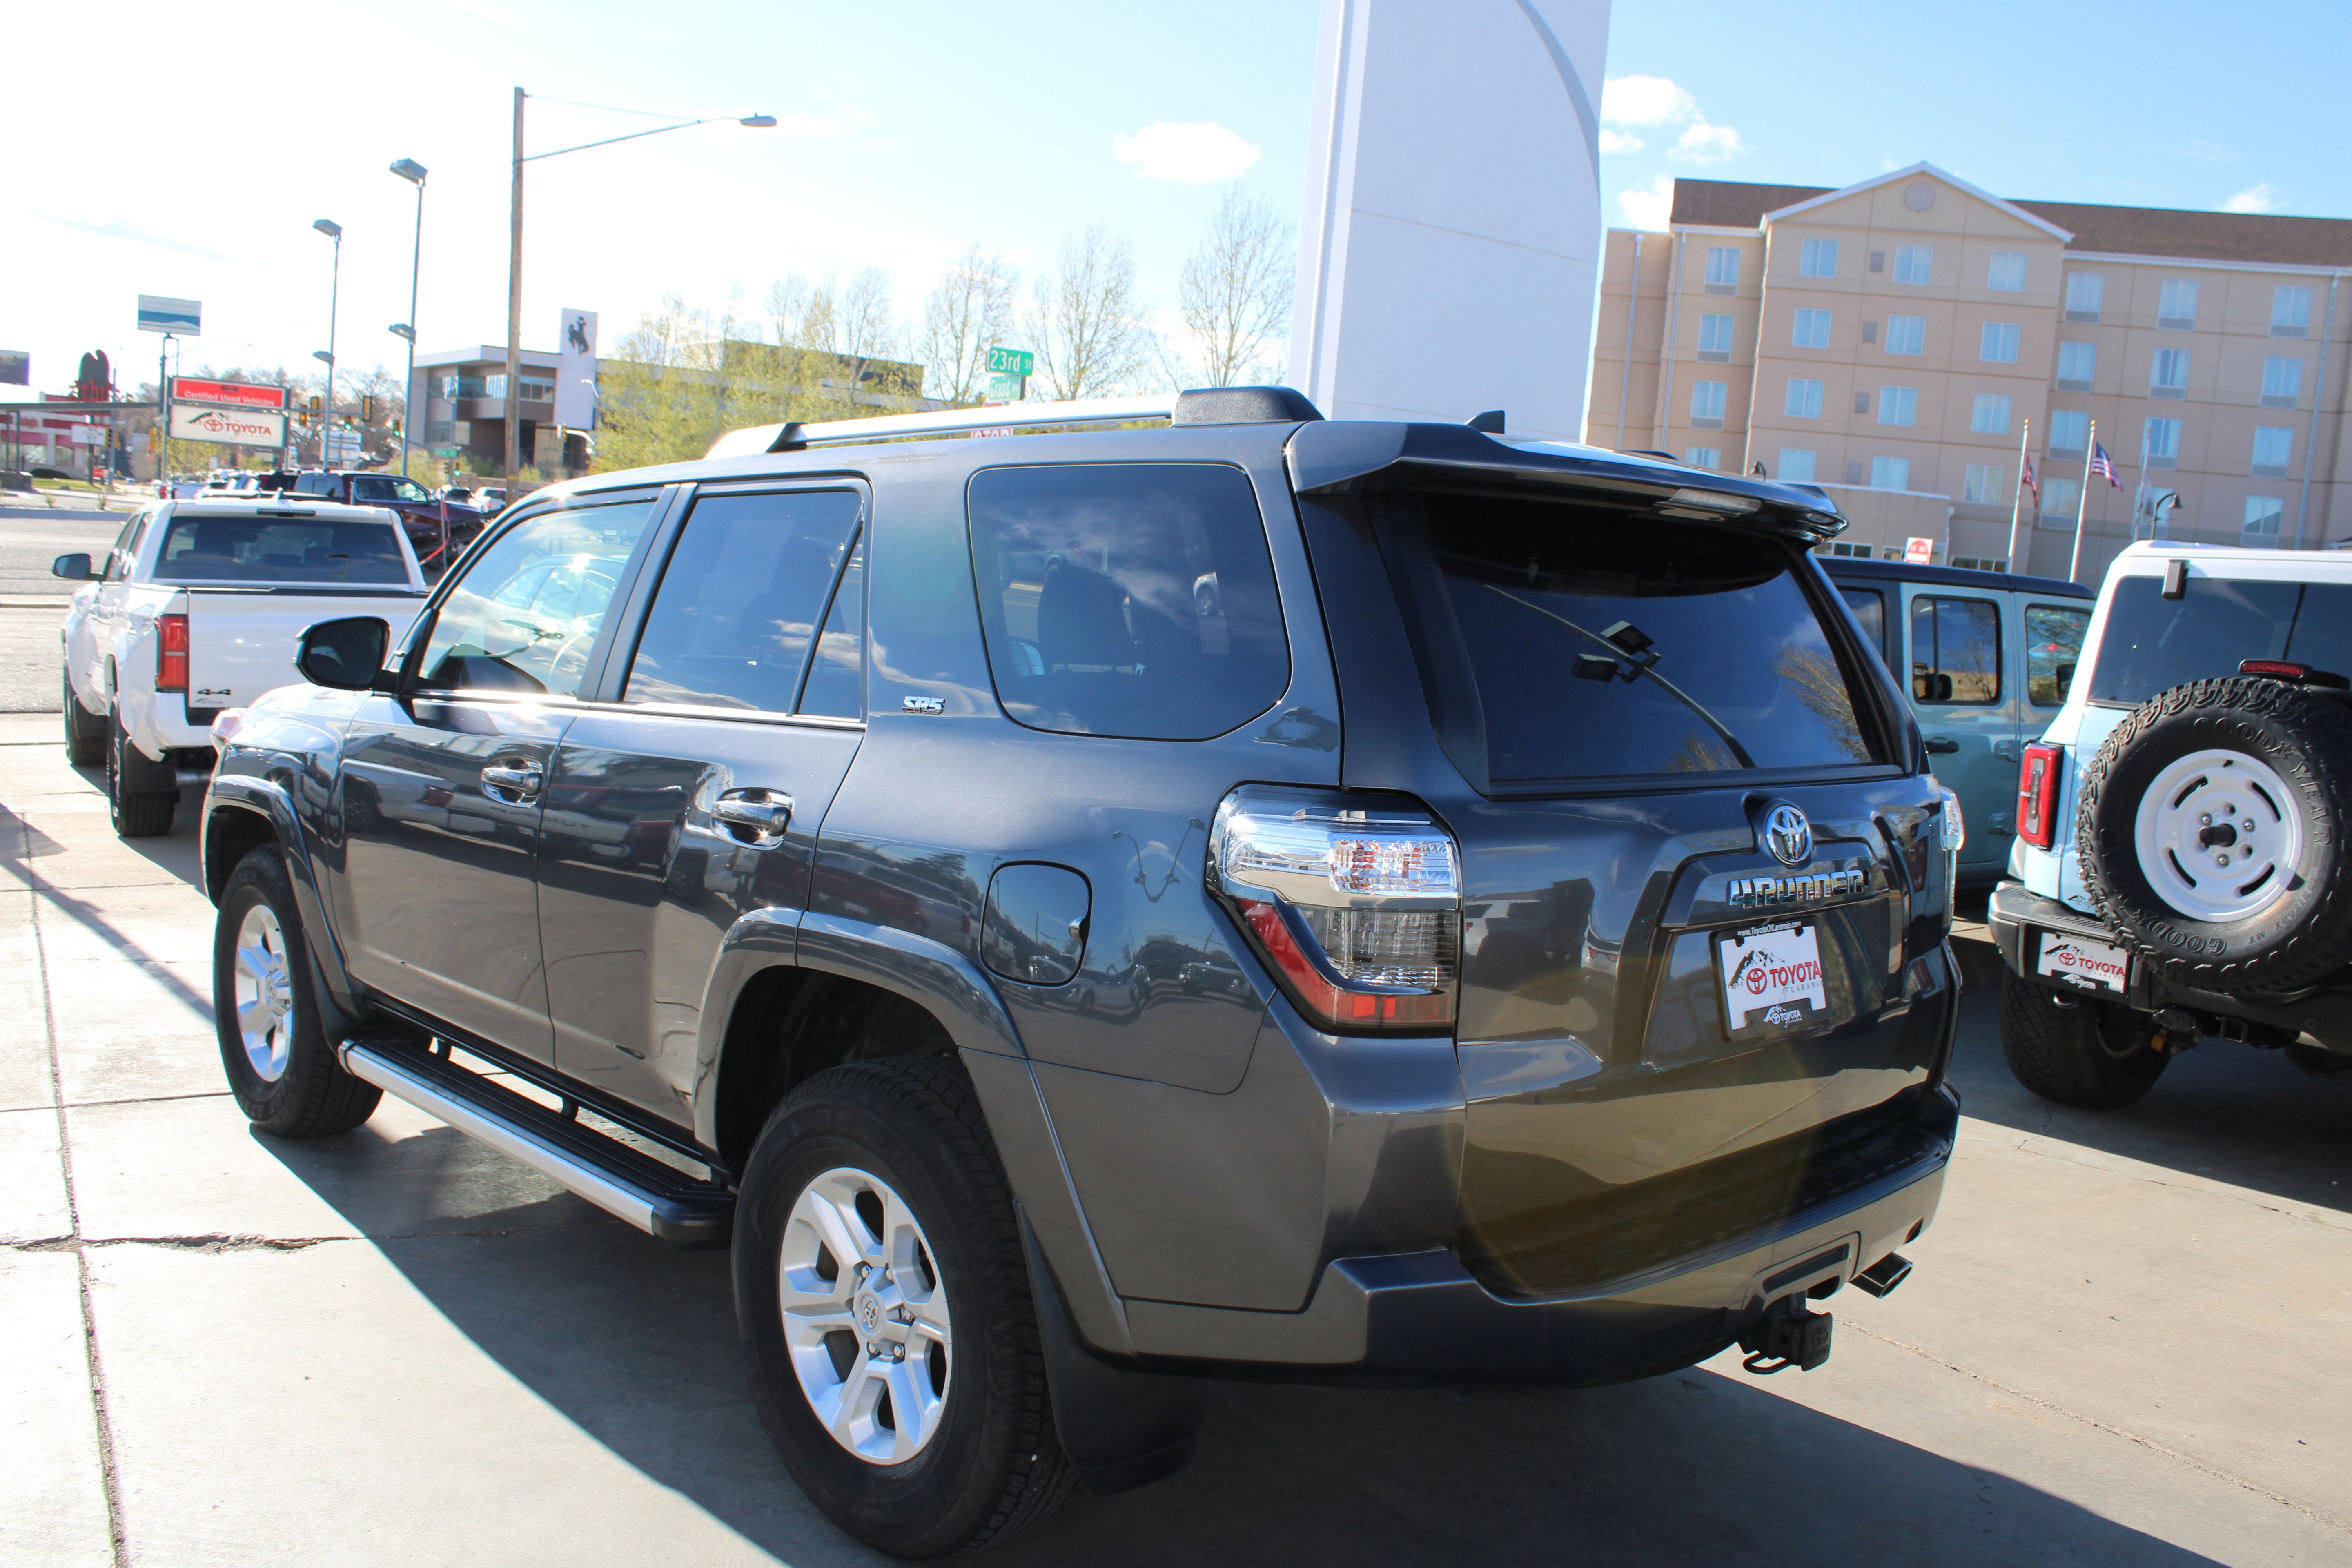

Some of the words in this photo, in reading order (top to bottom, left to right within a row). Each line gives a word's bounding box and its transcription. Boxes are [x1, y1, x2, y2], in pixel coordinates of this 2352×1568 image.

[990, 350, 1020, 372] 23rd
[185, 390, 218, 400] Certified
[220, 394, 240, 403] Used
[242, 396, 275, 406] Vehicles
[225, 423, 272, 435] TOYOTA
[902, 696, 946, 715] SR5
[1769, 960, 1822, 988] TOYOTA
[2079, 958, 2126, 976] TOYOTA
[1791, 980, 1824, 993] LARAMIE
[1780, 1009, 1802, 1021] TOYOTA
